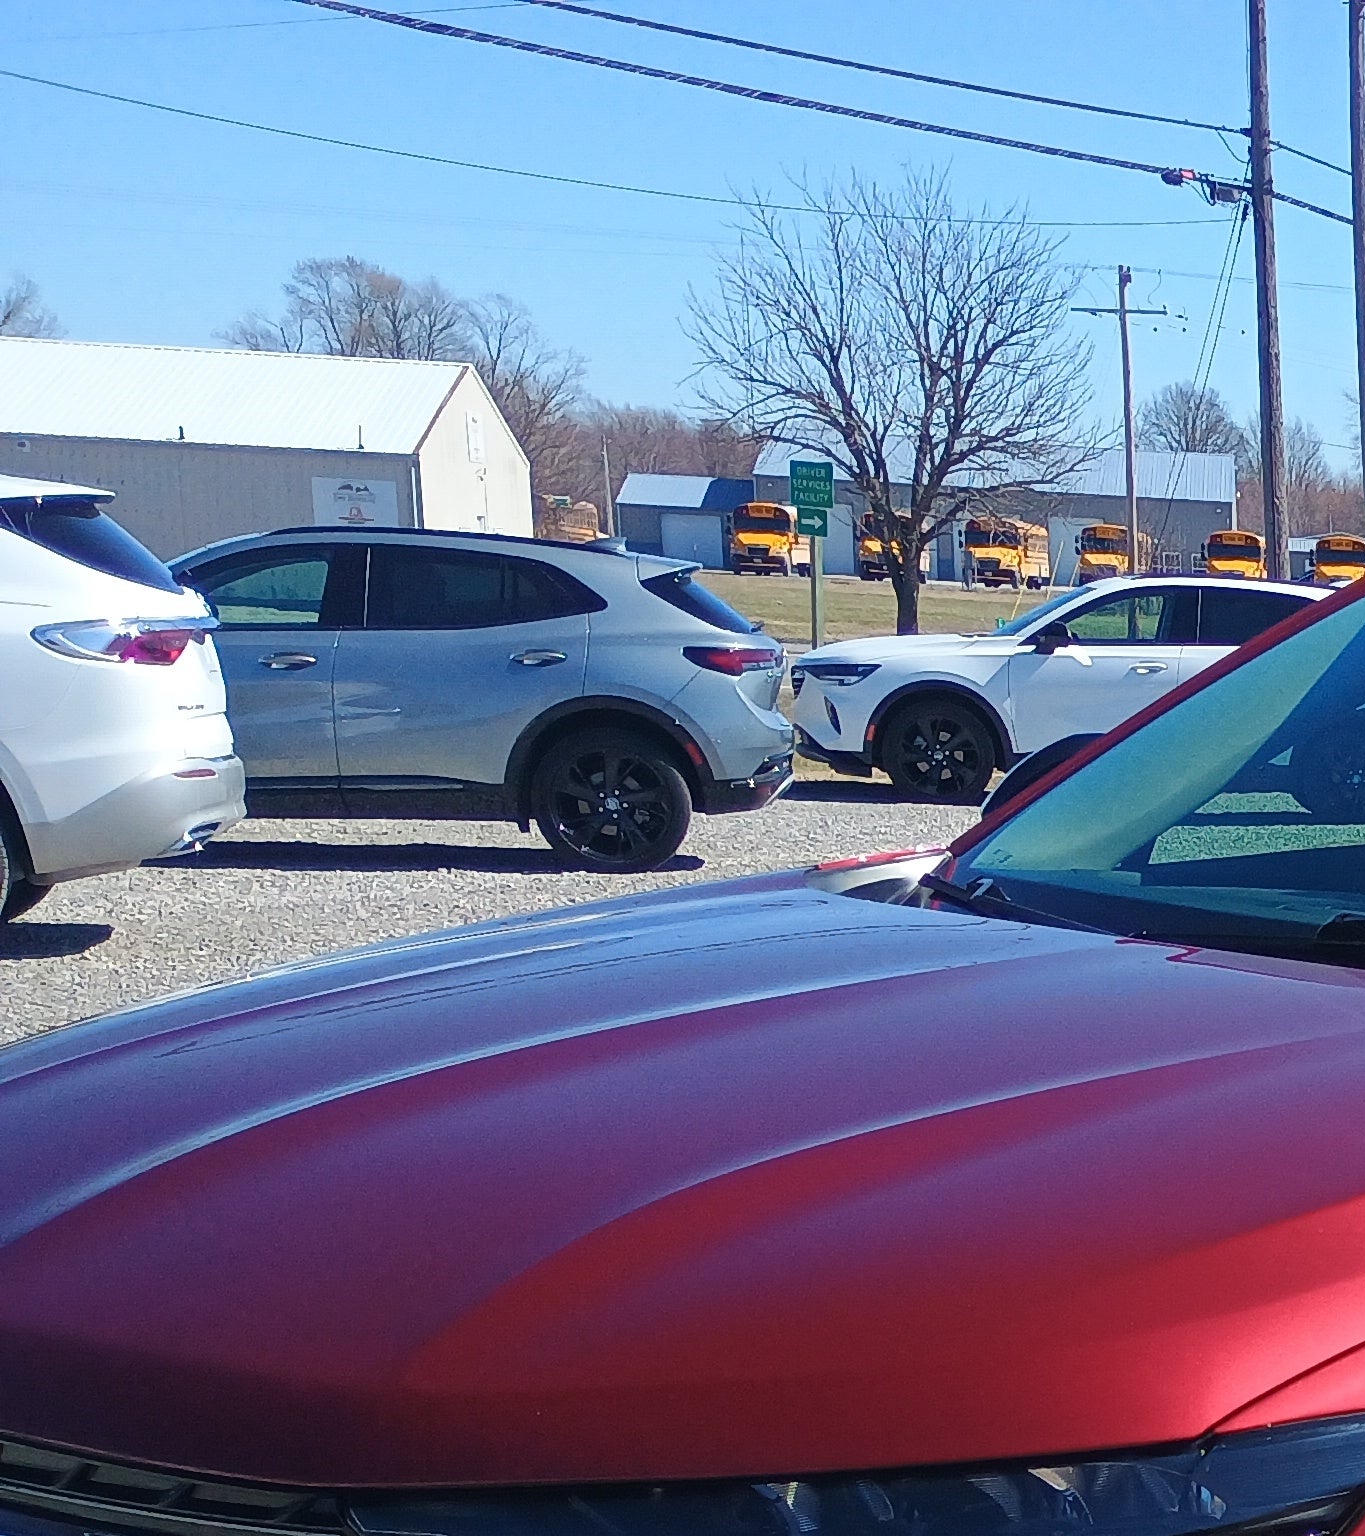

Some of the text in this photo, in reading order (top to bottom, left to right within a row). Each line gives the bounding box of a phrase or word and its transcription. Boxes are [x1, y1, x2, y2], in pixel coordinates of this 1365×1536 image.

[797, 467, 826, 478] DRIVER
[793, 479, 830, 490] SERVICES
[794, 491, 829, 502] FACILITY
